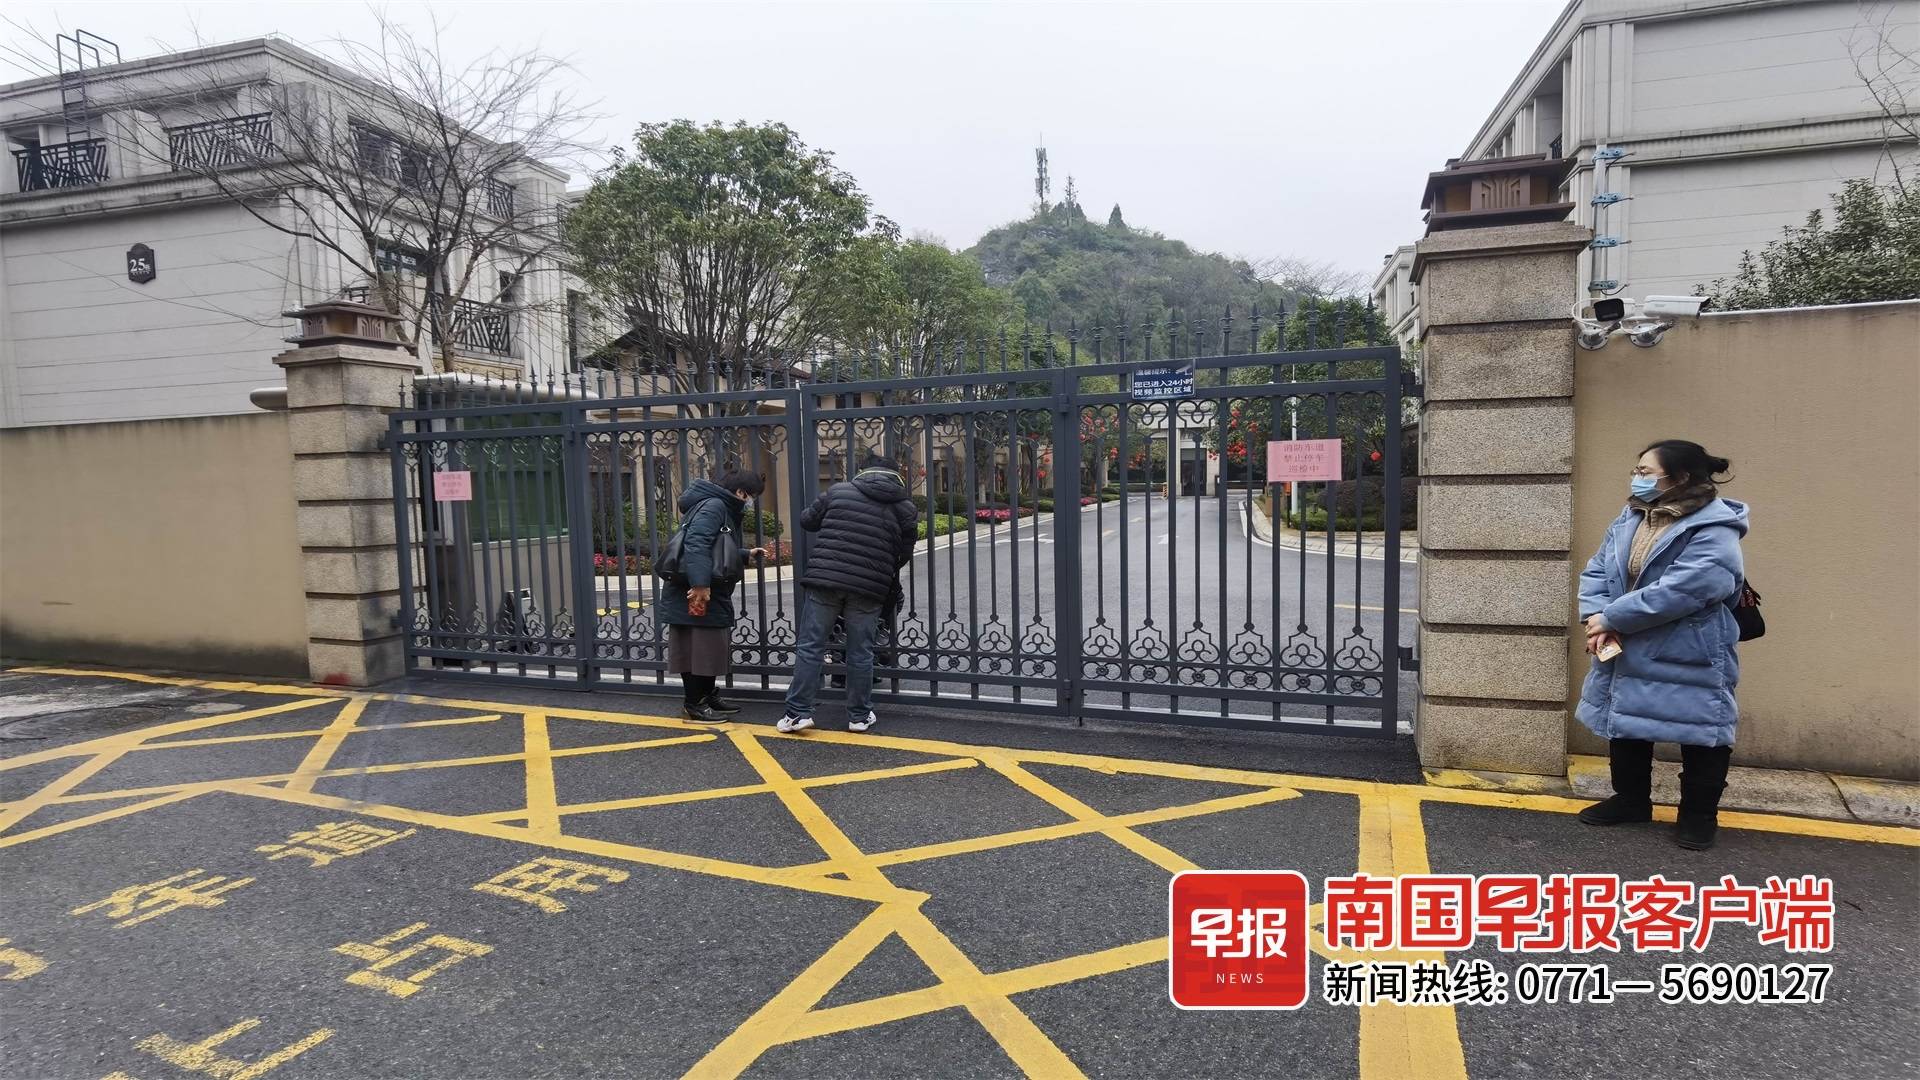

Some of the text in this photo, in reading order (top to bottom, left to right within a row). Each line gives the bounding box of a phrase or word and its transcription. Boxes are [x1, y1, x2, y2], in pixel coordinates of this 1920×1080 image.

[1134, 385, 1192, 396] 视频监控区域
